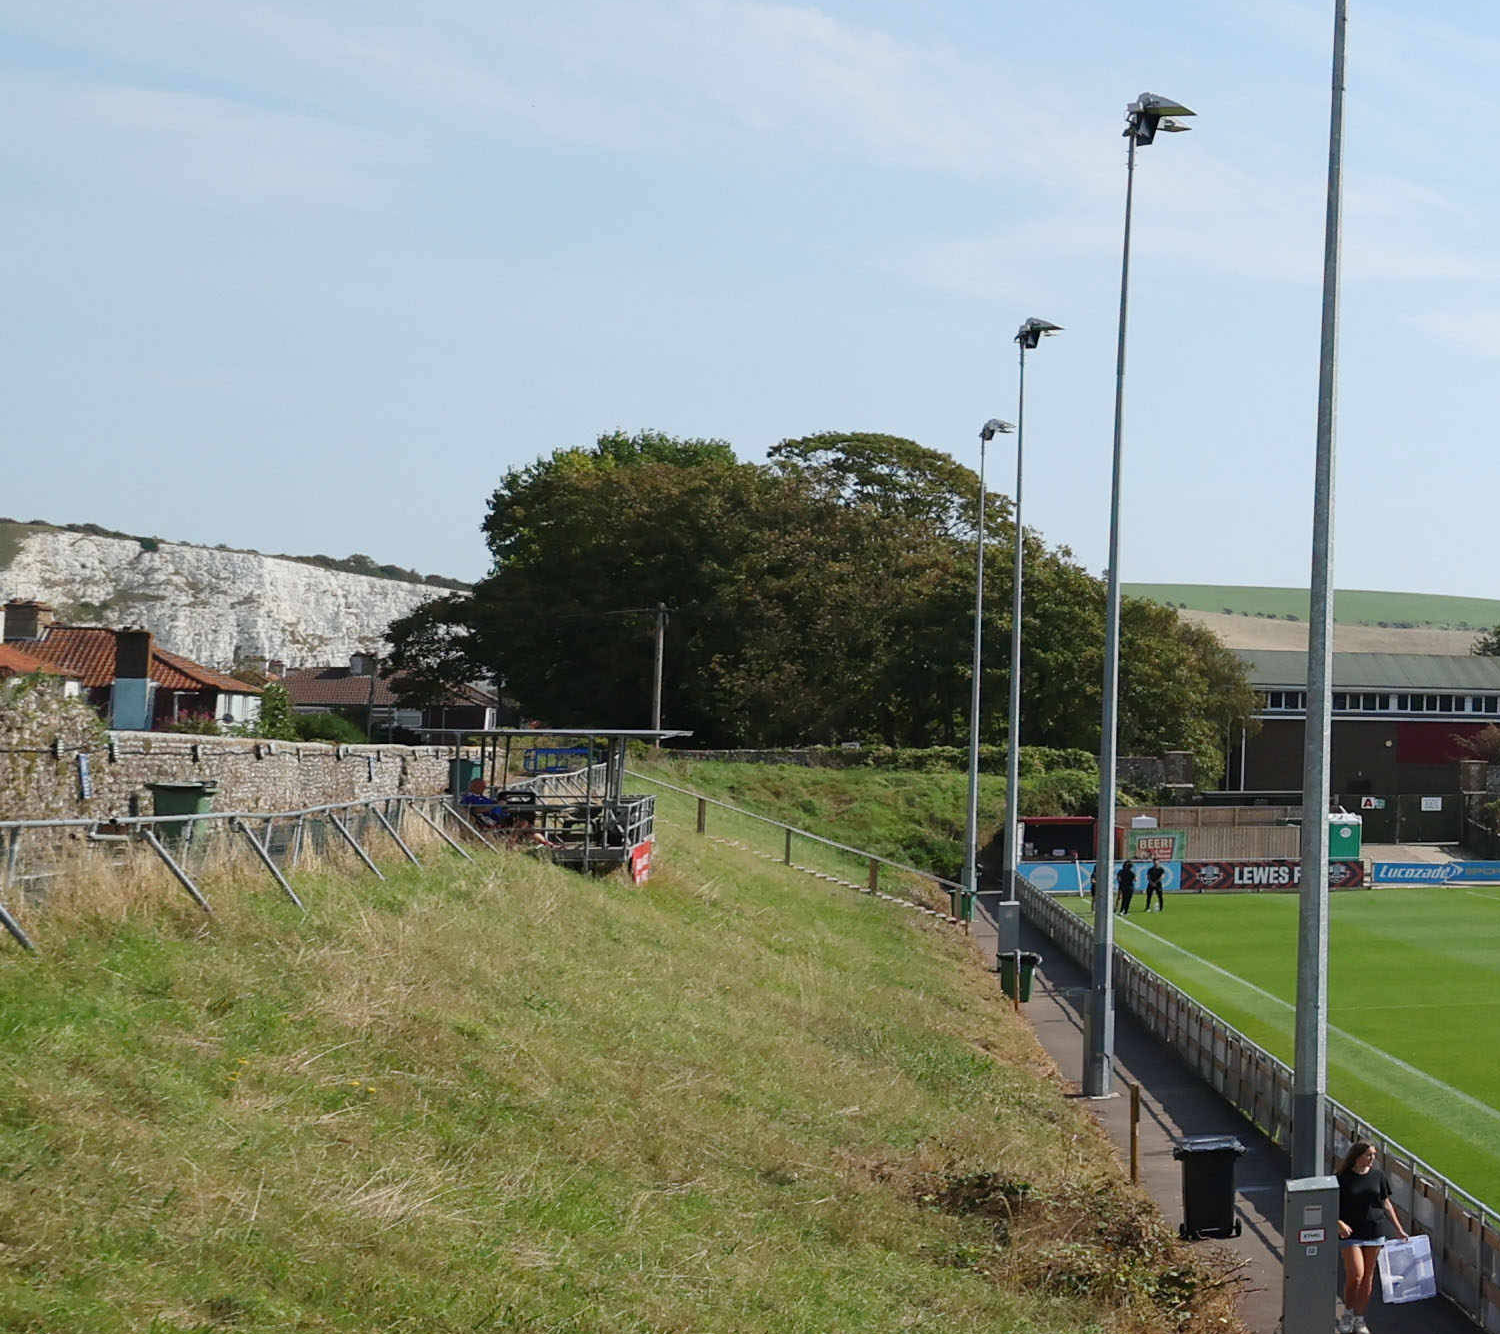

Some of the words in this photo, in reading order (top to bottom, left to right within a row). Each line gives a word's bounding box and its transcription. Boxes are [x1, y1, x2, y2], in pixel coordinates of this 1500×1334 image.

[1139, 838, 1173, 850] BEER!
[1233, 866, 1290, 885] LEWES
[1379, 864, 1452, 880] Lucozade
